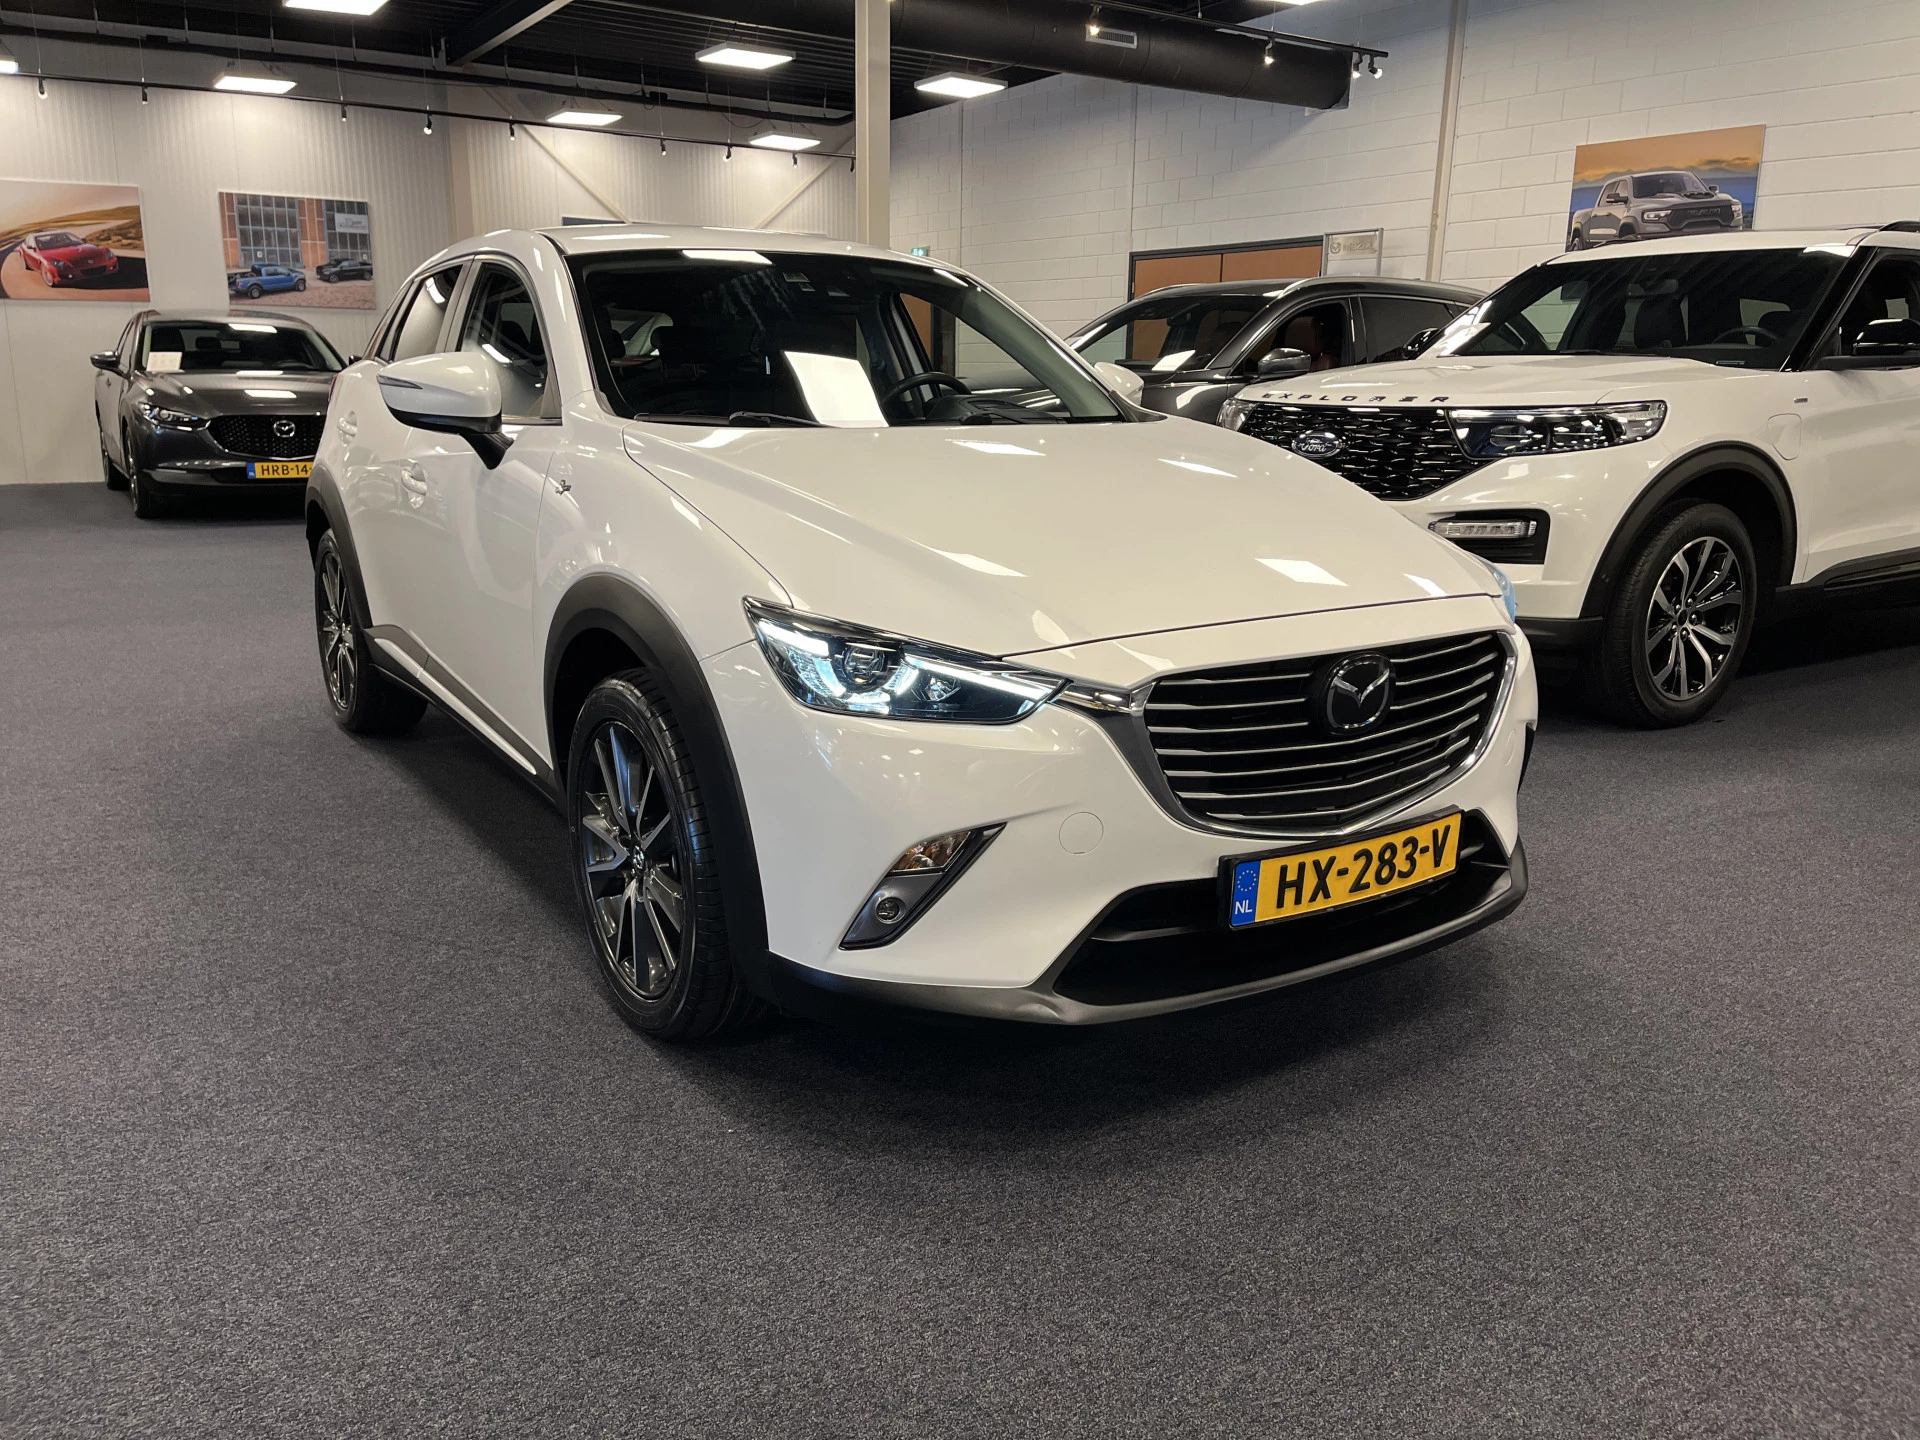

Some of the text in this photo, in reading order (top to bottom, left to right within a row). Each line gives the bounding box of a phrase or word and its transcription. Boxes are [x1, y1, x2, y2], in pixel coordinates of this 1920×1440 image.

[1262, 393, 1449, 402] EXPLORER
[1298, 437, 1329, 452] Ford
[1276, 824, 1451, 909] HX-283-V
[1234, 901, 1252, 915] NL
